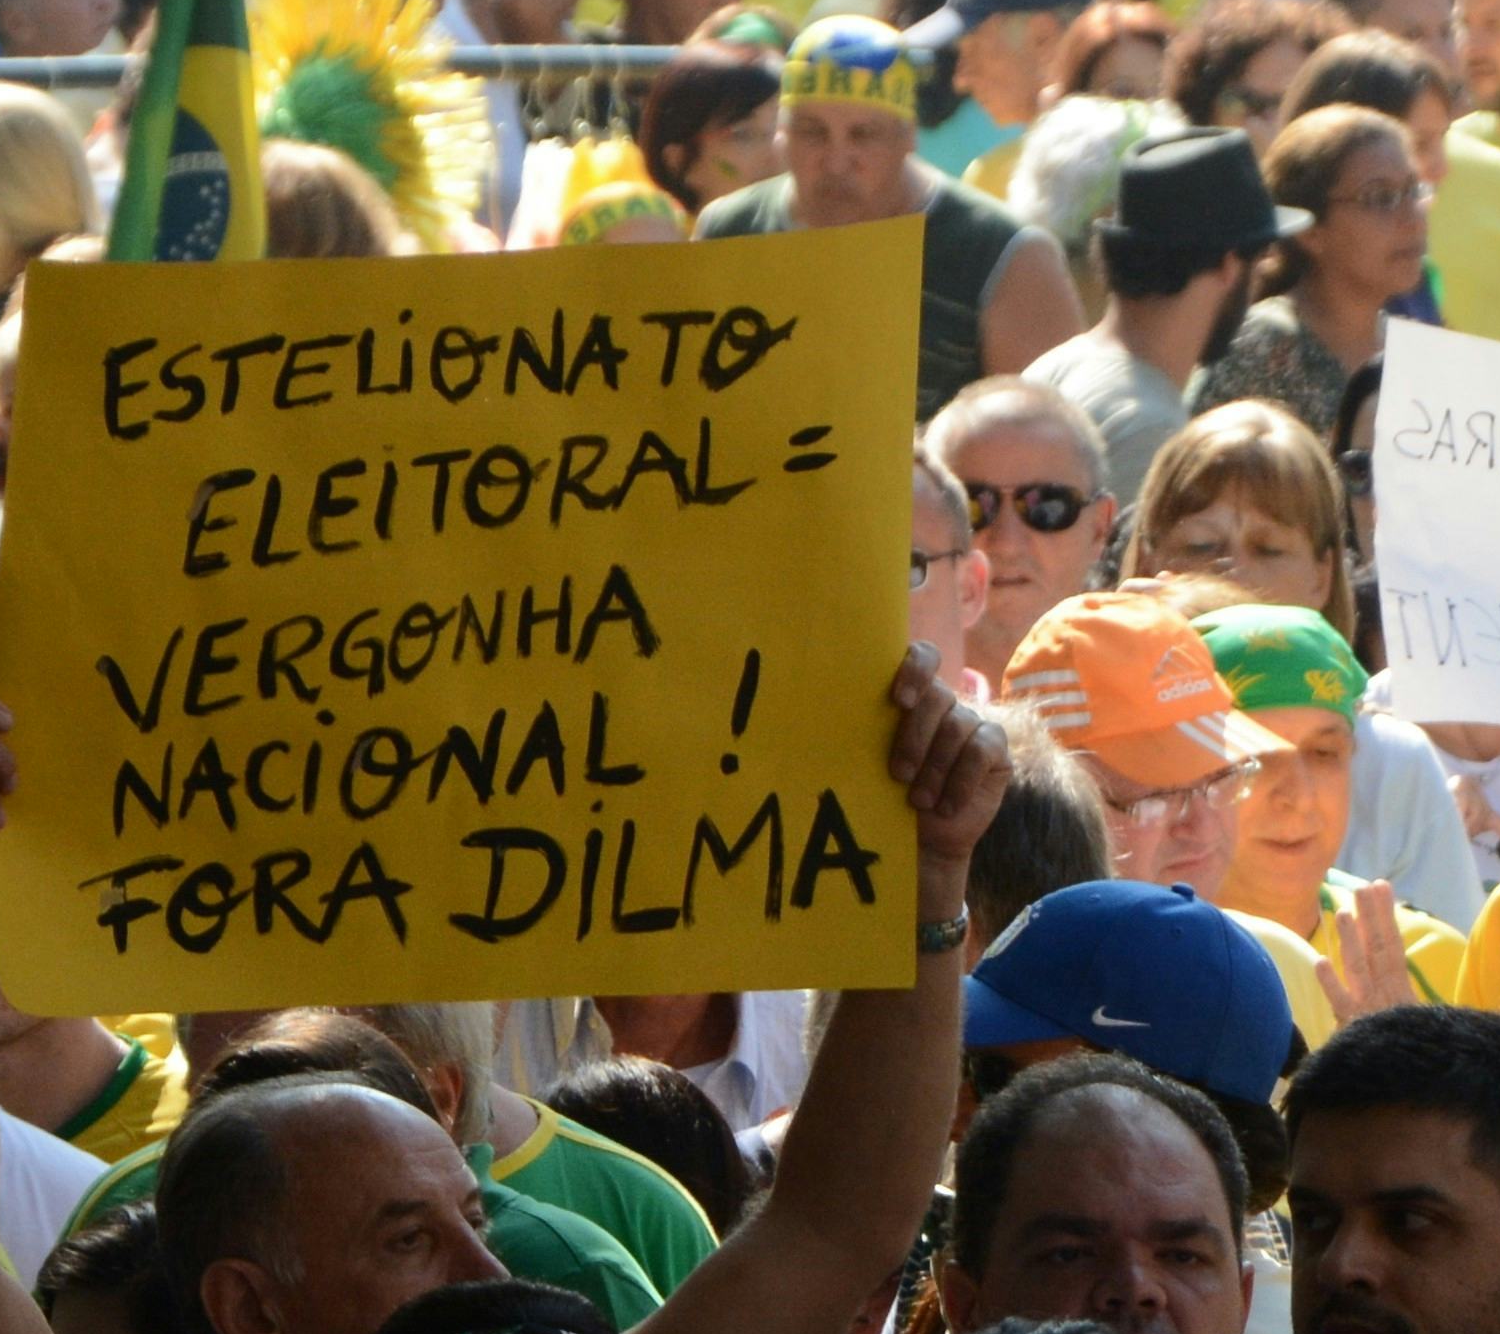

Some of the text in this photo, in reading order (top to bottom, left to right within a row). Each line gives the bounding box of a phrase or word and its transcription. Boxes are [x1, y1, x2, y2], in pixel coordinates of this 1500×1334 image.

[96, 564, 661, 734] VERGONHA
[111, 691, 647, 839] NACIONAL
[77, 788, 883, 955] FORA DILMA
